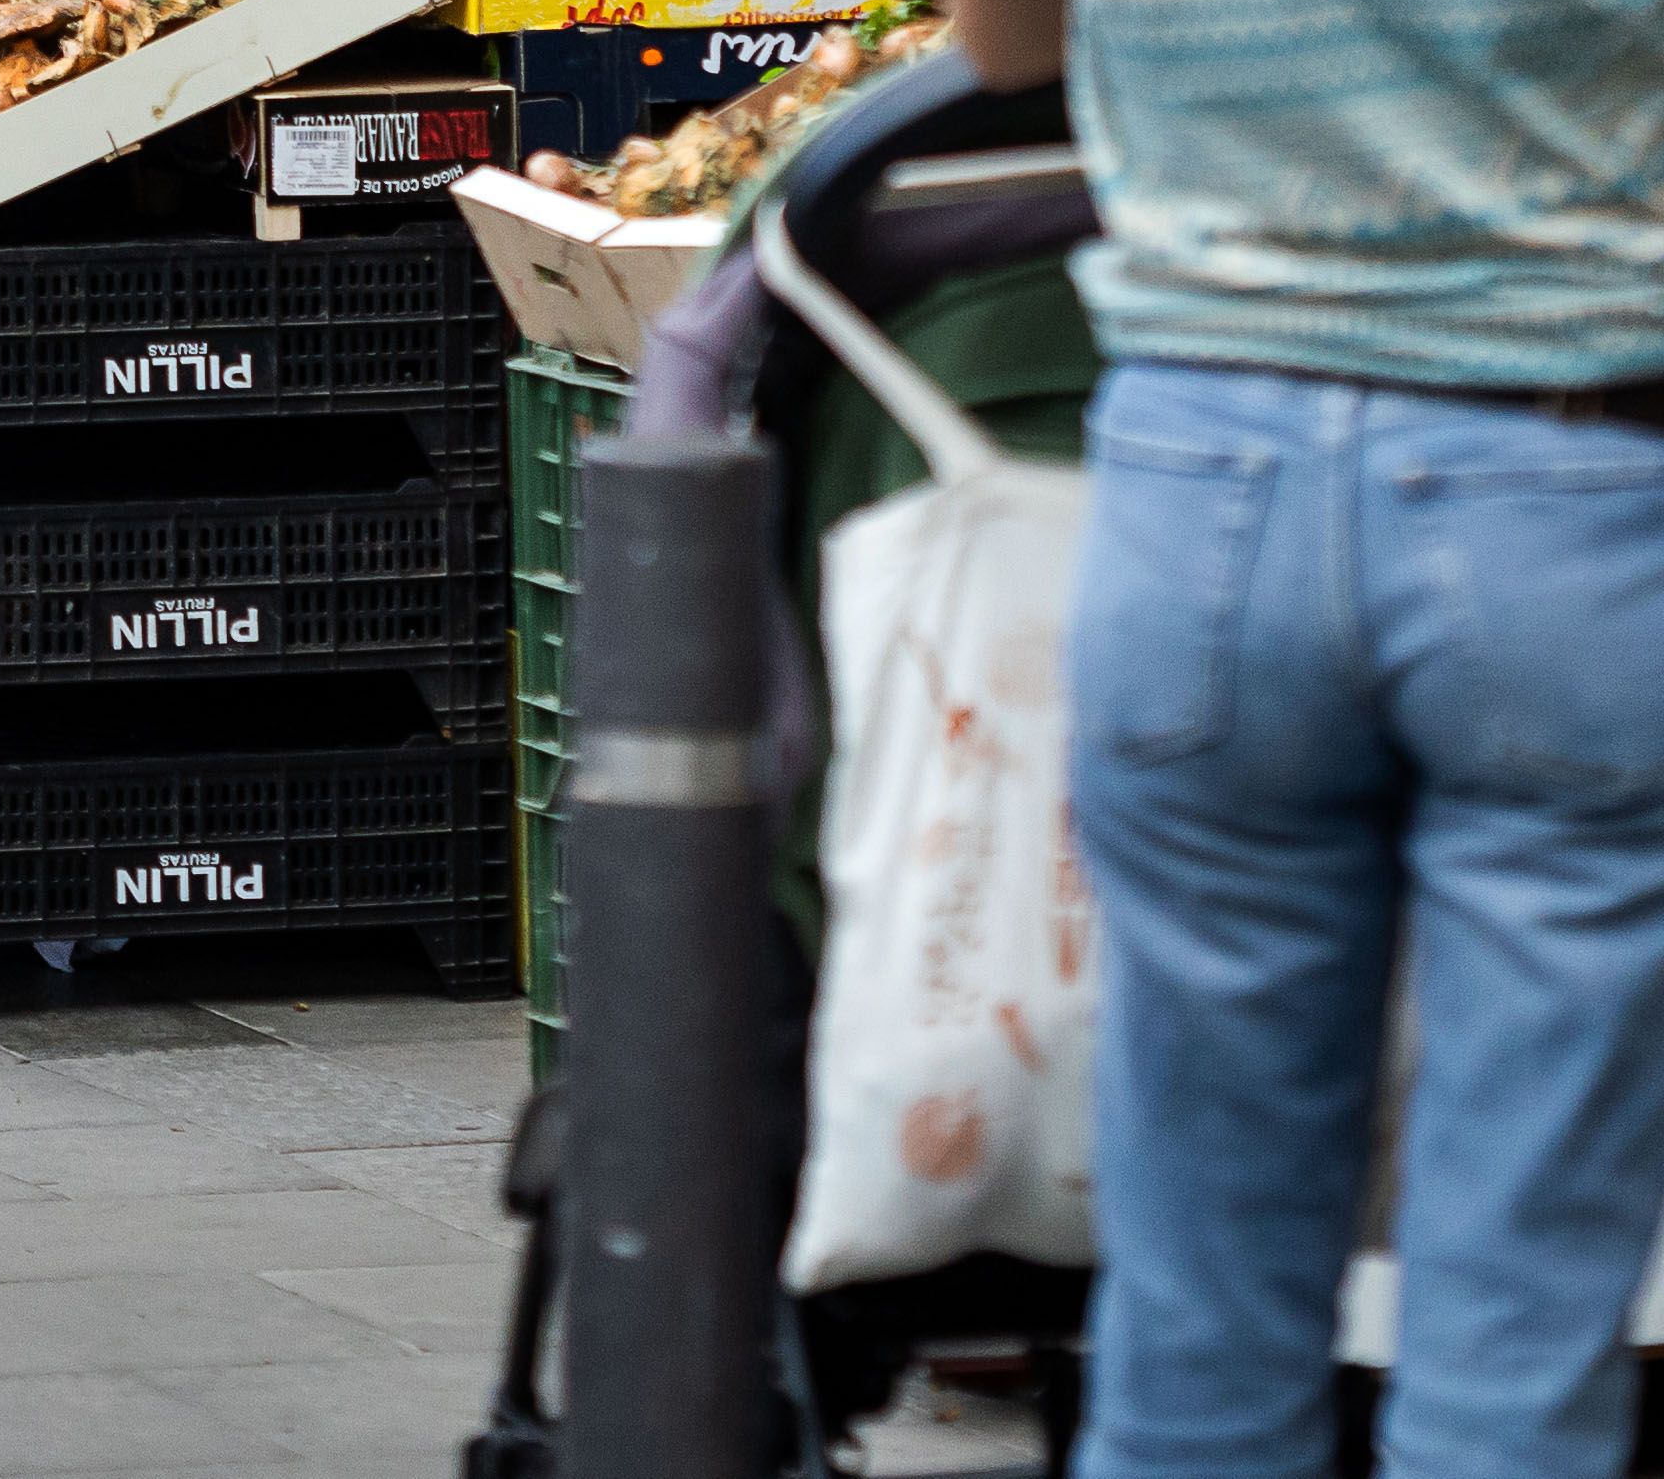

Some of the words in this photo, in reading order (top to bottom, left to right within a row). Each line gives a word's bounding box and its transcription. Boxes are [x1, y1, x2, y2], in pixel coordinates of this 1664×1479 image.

[420, 163, 464, 191] HIGOS
[362, 179, 382, 194] DE
[383, 178, 420, 194] COLL
[147, 342, 208, 356] FRUTAS
[104, 352, 253, 395] PILLIN
[154, 597, 216, 611] FRUTAS
[112, 607, 260, 651] PILLIN
[158, 852, 220, 867] FRUTAS
[116, 862, 264, 905] PILLIN
